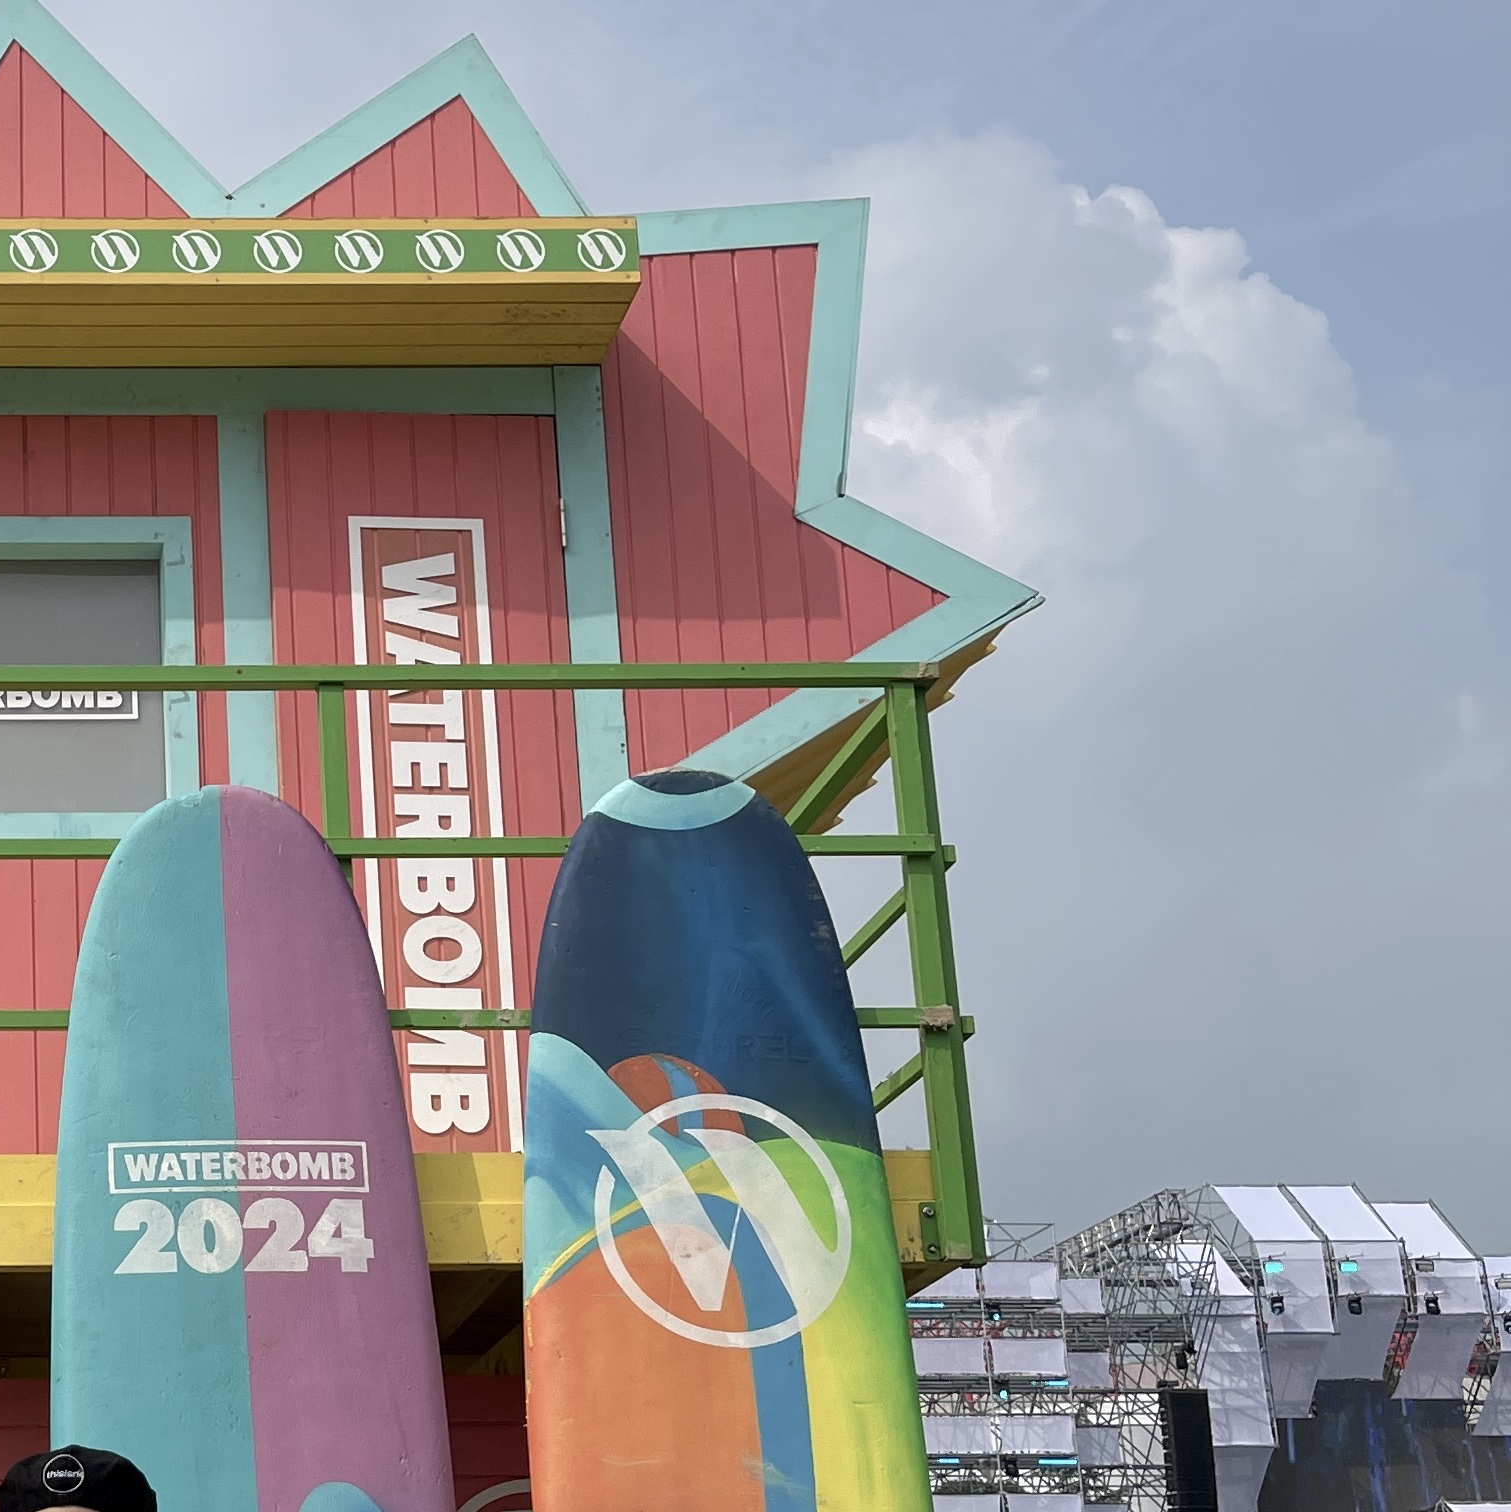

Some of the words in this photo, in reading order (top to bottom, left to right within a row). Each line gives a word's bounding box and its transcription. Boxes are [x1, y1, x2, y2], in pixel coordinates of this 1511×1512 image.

[381, 553, 490, 1134] WATERBOMB
[124, 1151, 356, 1182] WATERBOMB
[113, 1197, 374, 1274] 2024
